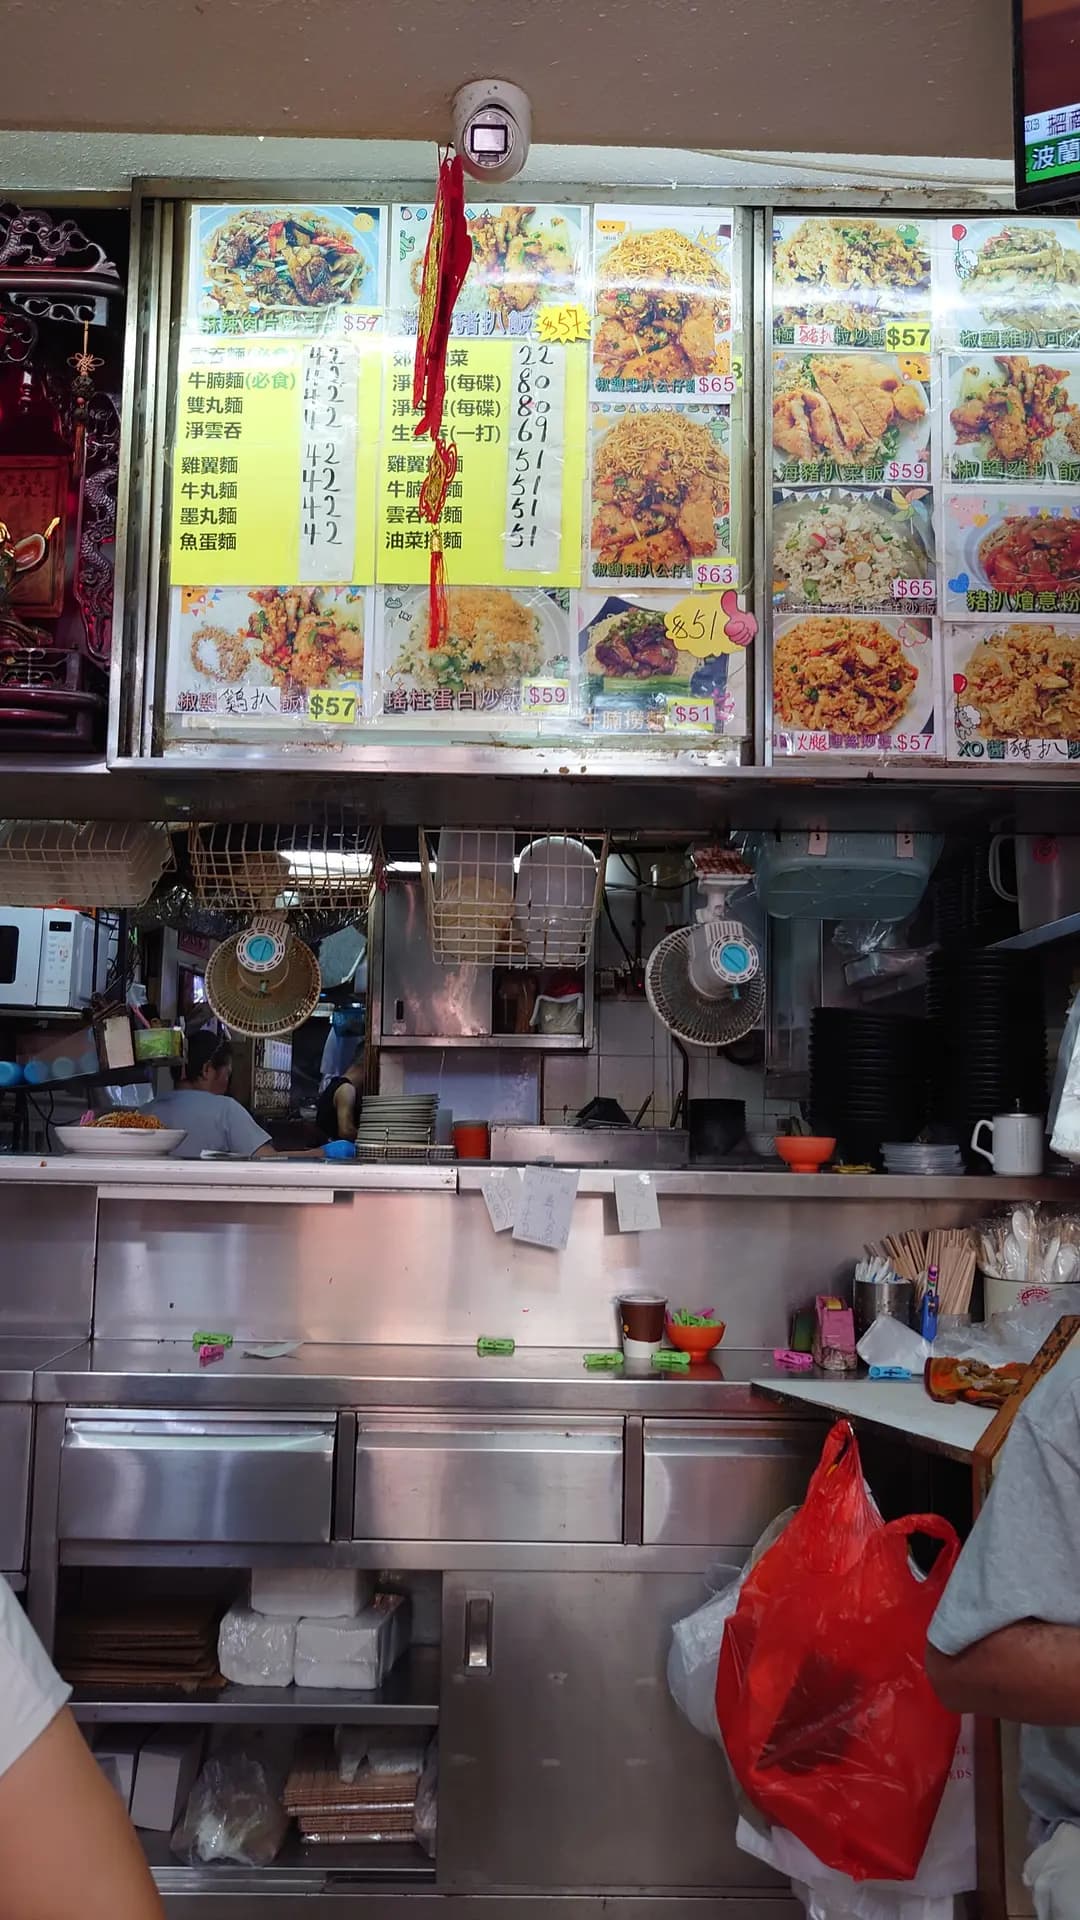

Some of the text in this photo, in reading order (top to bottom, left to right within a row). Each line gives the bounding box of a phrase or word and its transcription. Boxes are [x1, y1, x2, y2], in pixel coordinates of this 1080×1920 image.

[542, 309, 581, 334] $57
[887, 327, 930, 349] $57
[519, 345, 553, 365] 22
[188, 372, 297, 390] 牛腩麵(必食)
[518, 368, 550, 394] 80
[699, 376, 735, 393] $65
[188, 396, 243, 414] 雙丸麵
[517, 394, 550, 417] 80
[186, 421, 242, 439] 淨雲吞
[518, 416, 547, 442] 69
[306, 442, 341, 467] 42
[515, 448, 543, 472] 51
[181, 456, 238, 474] 雞翼麵
[889, 461, 924, 480] $59
[303, 468, 341, 492] 42
[387, 480, 463, 498] 牛腩麵
[511, 474, 541, 496] 51
[181, 481, 238, 500] 牛丸麵
[180, 507, 237, 525] 墨丸麵
[303, 495, 342, 519] 42
[511, 498, 538, 518] 51
[179, 532, 237, 551] 魚蛋麵
[304, 521, 342, 545] 42
[510, 523, 537, 548] 51
[697, 564, 733, 584] $63
[897, 580, 933, 598] $65
[529, 686, 566, 704] $59
[310, 694, 356, 720] $57
[676, 705, 711, 722] $51
[897, 735, 933, 751] $57
